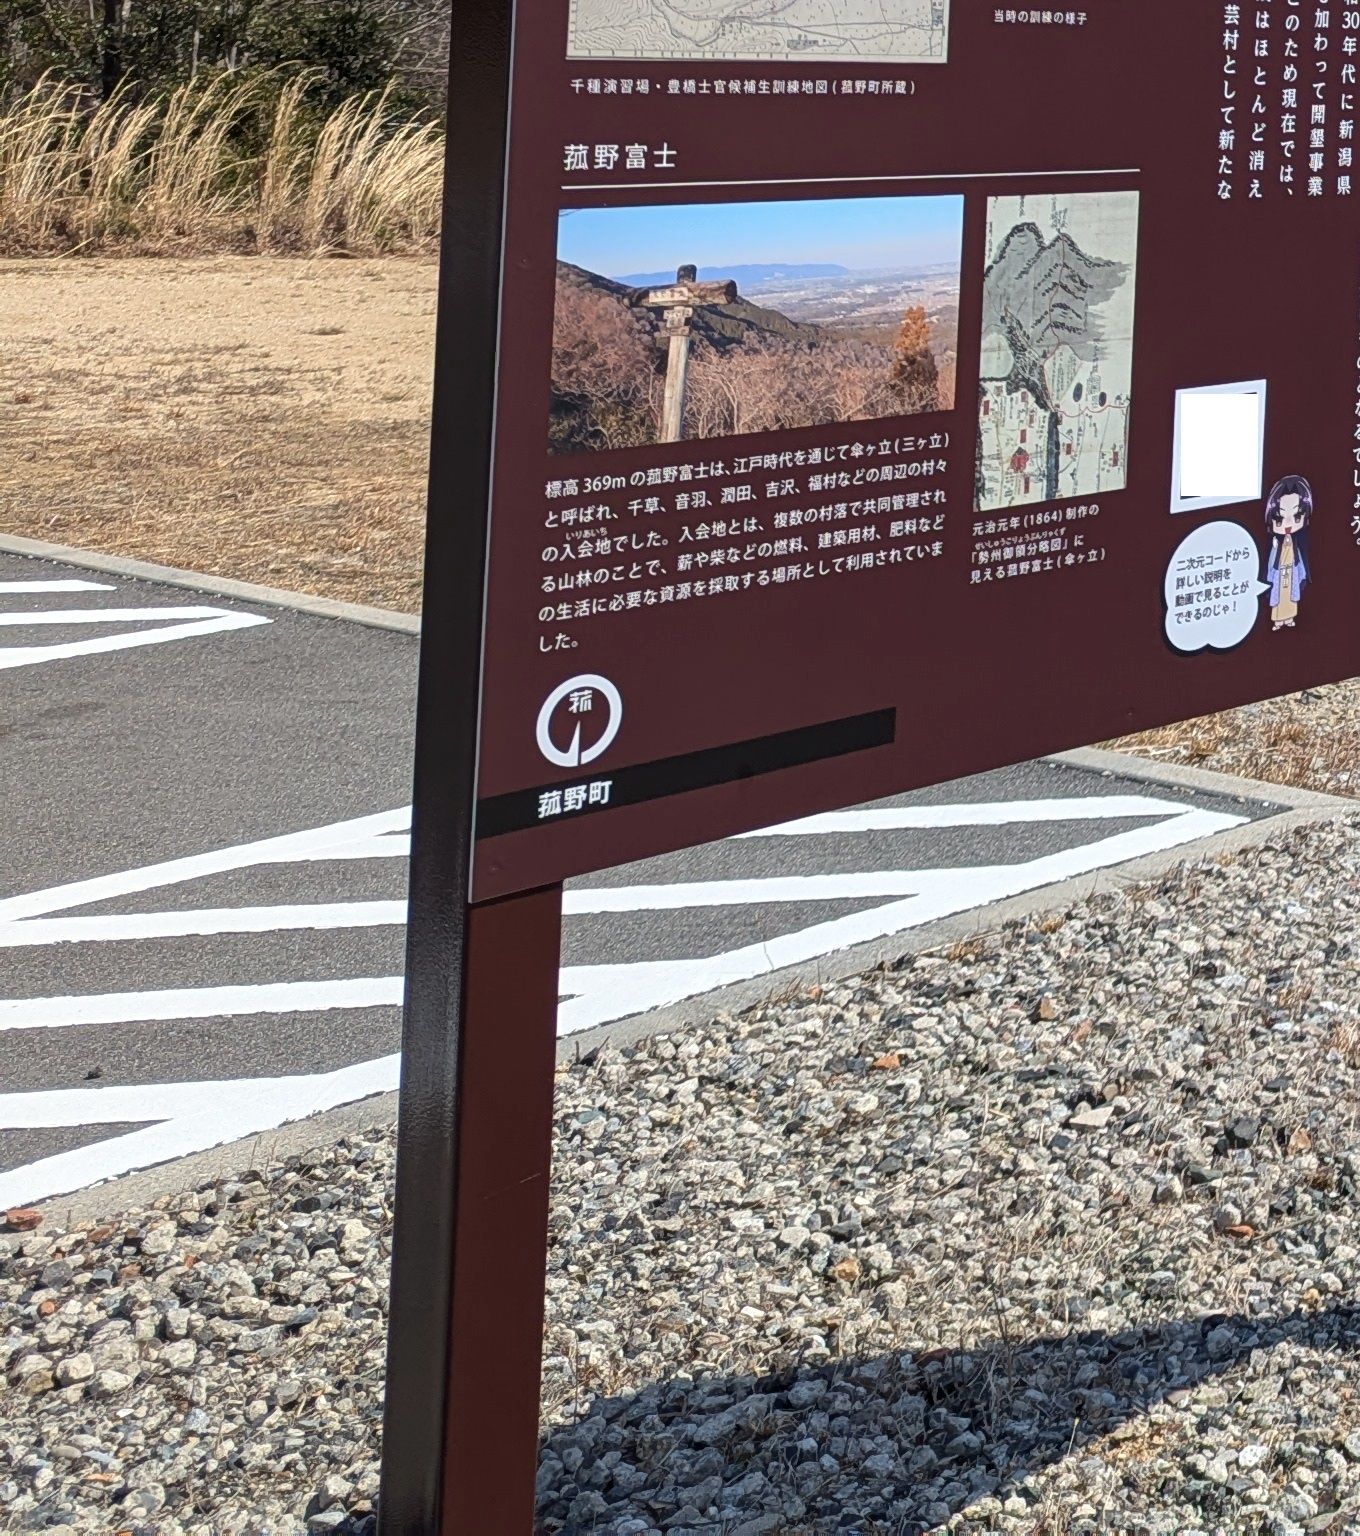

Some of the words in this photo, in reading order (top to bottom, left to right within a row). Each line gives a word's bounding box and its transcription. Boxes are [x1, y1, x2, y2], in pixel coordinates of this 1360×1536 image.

[994, 9, 1088, 25] 当時の訓練の様子
[563, 142, 677, 171] 菰野富士
[566, 526, 608, 541] いりあいち
[1176, 547, 1250, 572] 二次元コードから
[1175, 568, 1232, 590] 詳しい説明を
[1174, 580, 1249, 608] 動画で見ることが
[539, 632, 579, 653] した。
[538, 780, 613, 819] 菰野町
